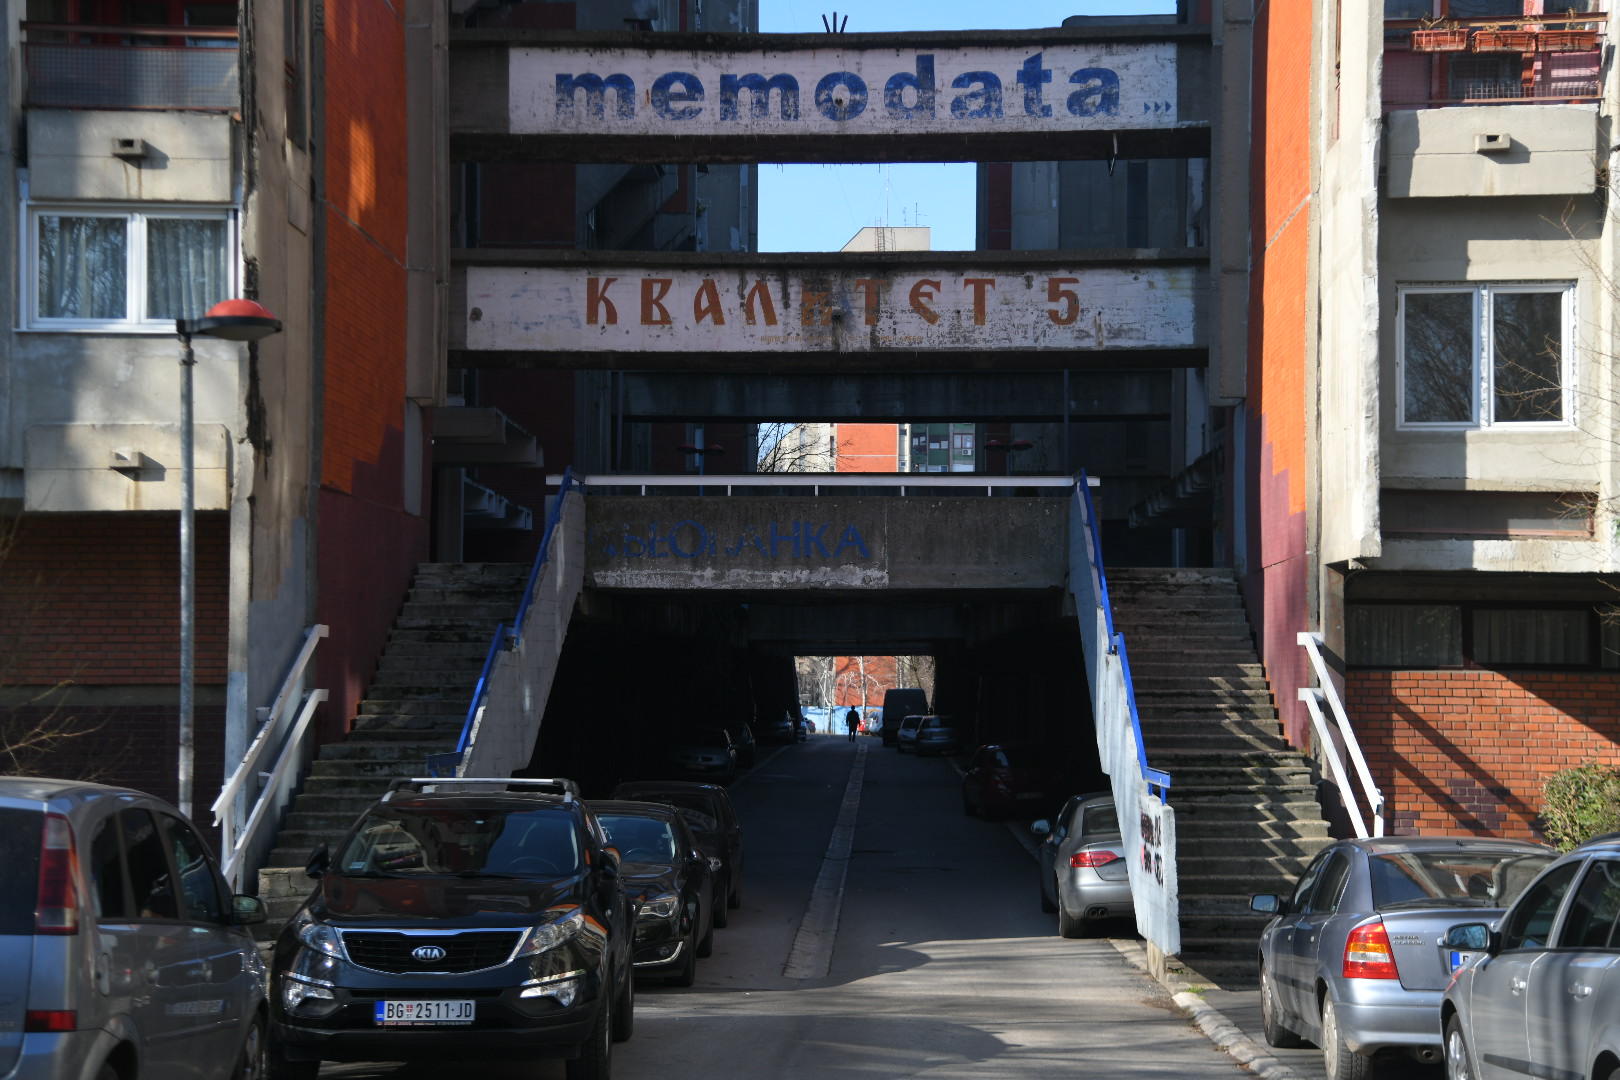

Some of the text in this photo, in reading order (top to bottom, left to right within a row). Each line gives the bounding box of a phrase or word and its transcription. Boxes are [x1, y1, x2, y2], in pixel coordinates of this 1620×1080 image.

[555, 51, 1120, 121] memodata
[1047, 277, 1080, 325] 5
[417, 948, 440, 959] KIA
[387, 1003, 404, 1018] BG
